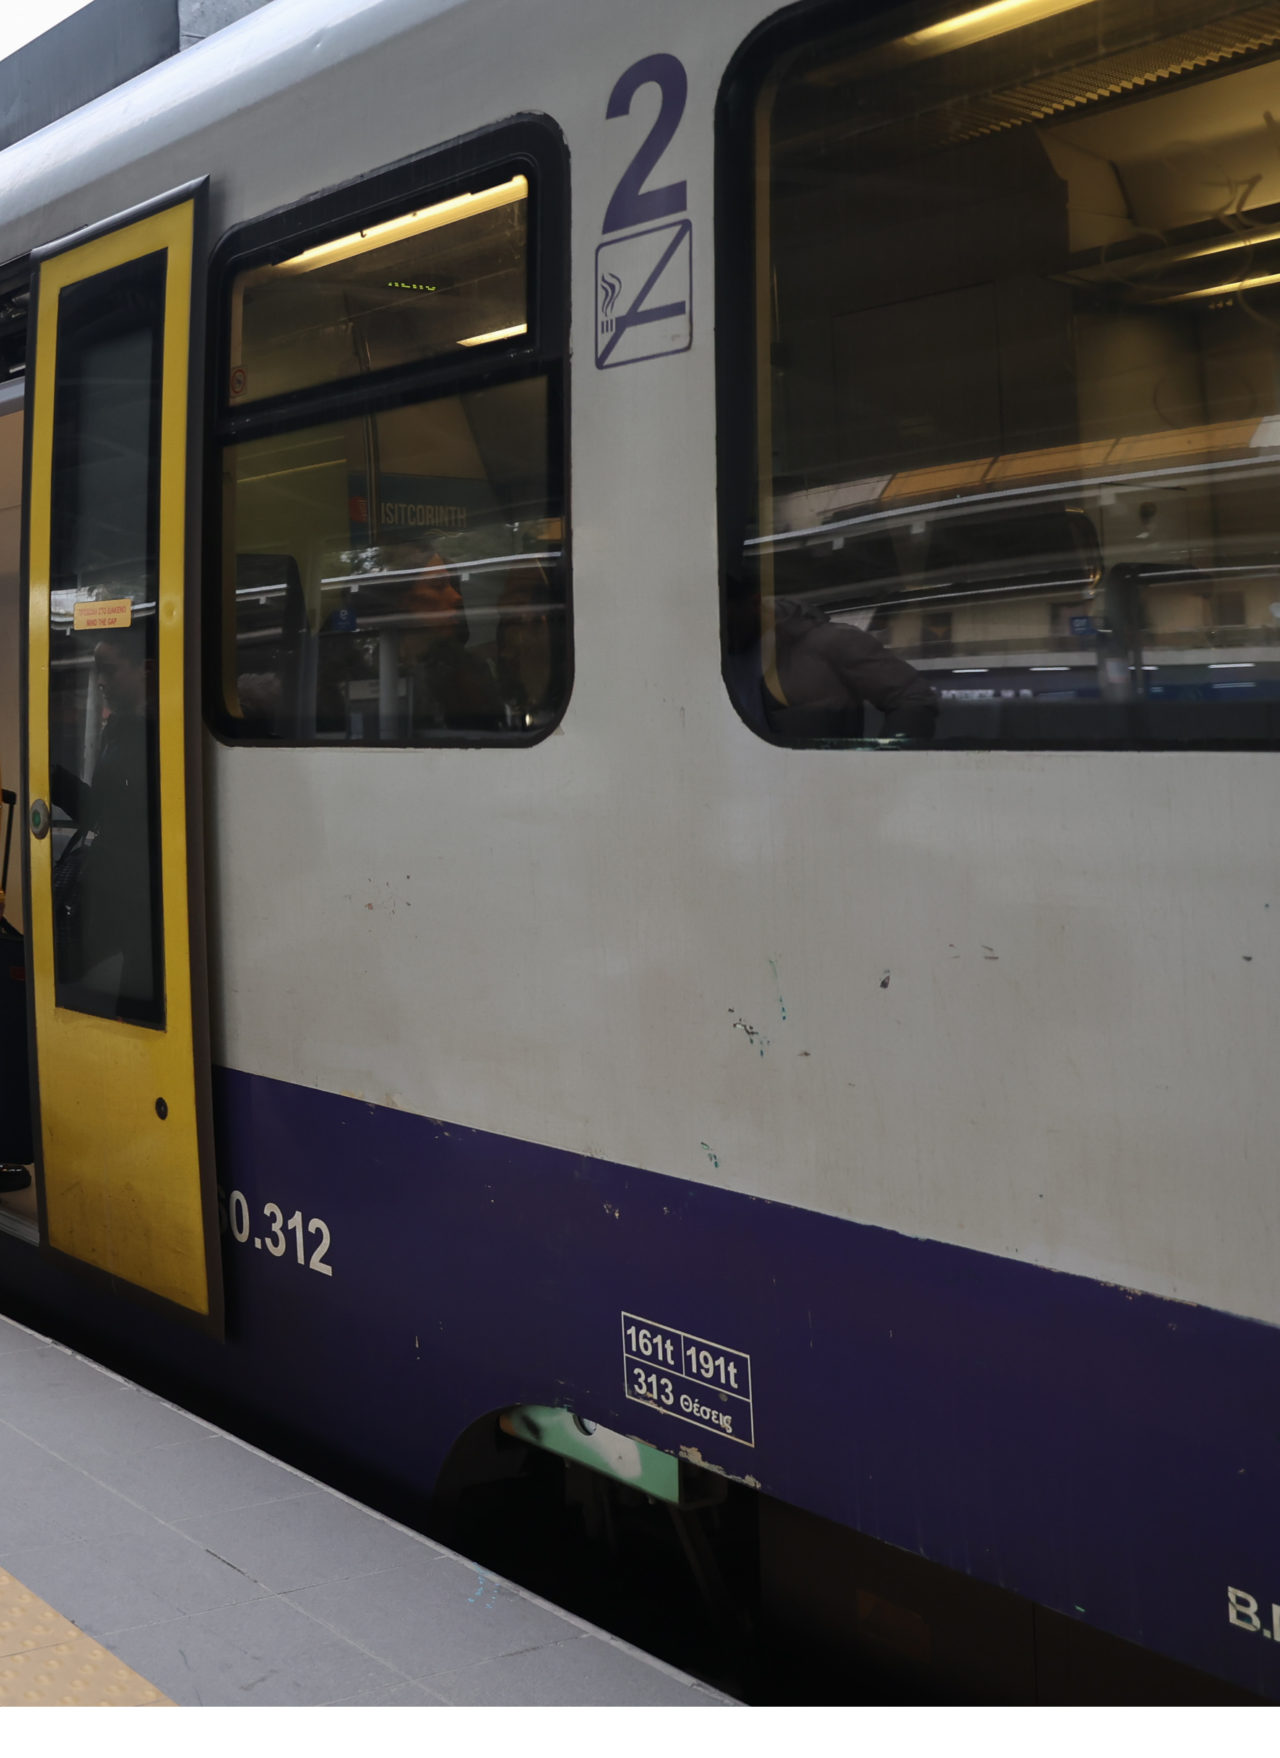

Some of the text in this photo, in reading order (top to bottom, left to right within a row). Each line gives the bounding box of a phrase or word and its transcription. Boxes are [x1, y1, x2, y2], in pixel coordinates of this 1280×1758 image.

[602, 53, 687, 234] 2
[380, 502, 467, 528] ISITCORINTH
[228, 1189, 333, 1277] 0.312
[626, 1325, 675, 1366] 161t
[686, 1346, 738, 1389] 191t
[633, 1367, 733, 1433] 313 Θέσεις
